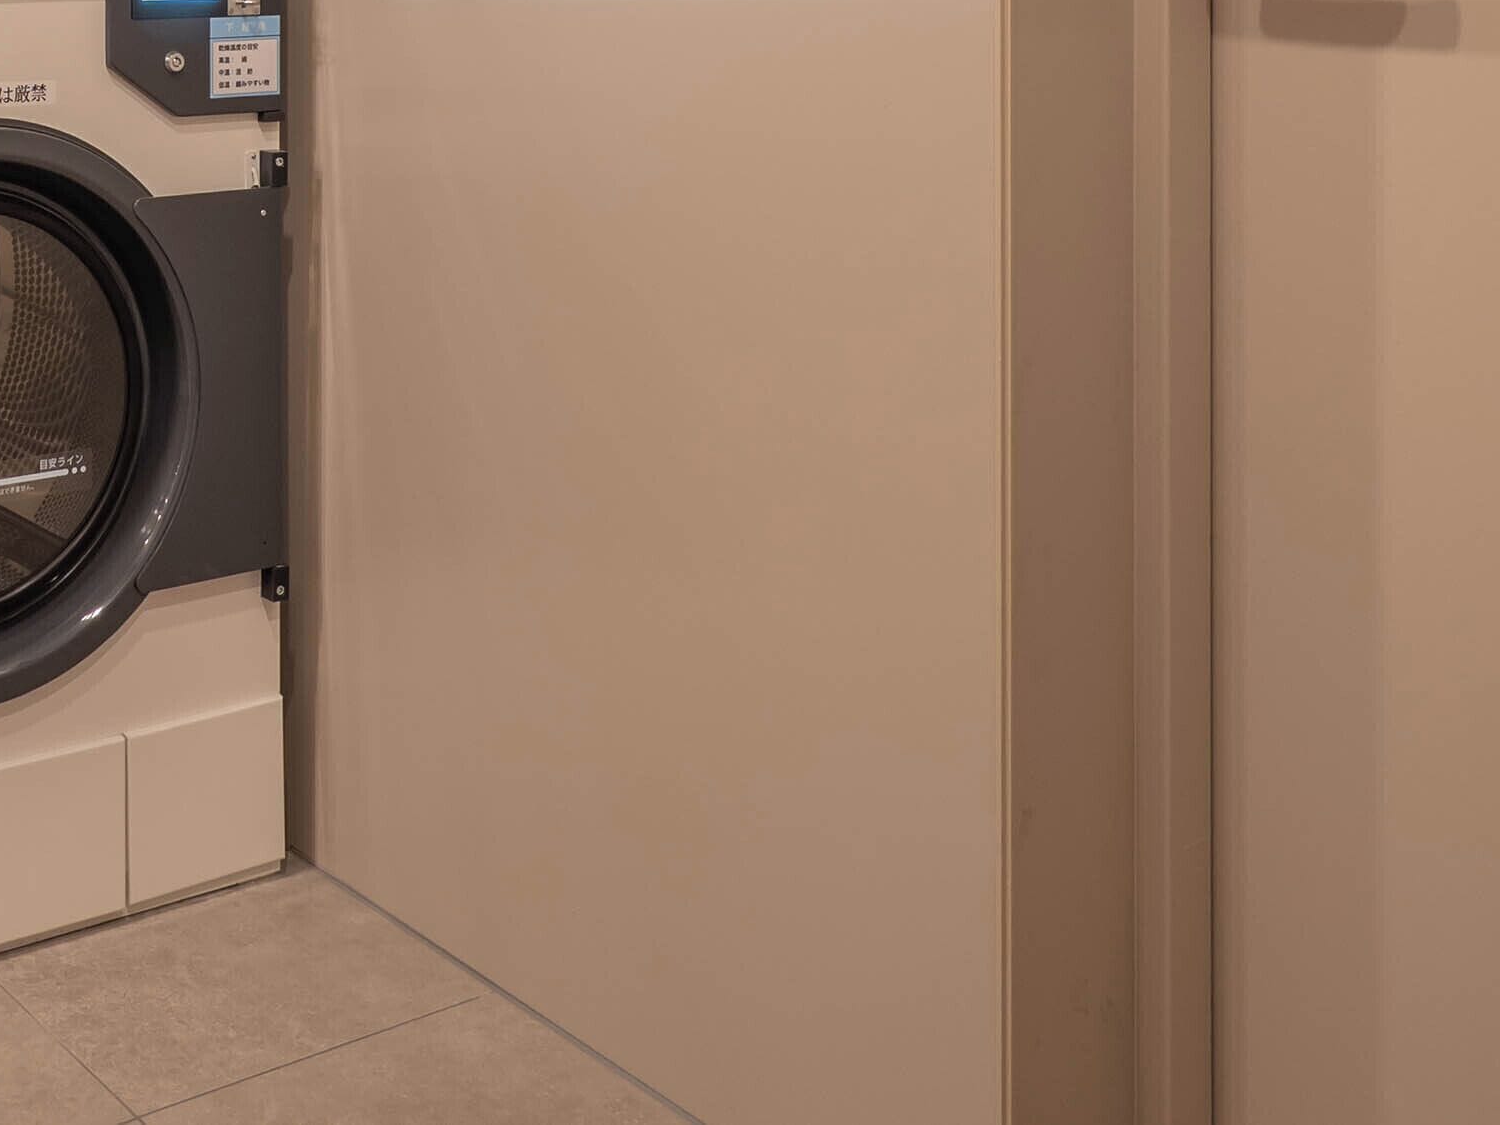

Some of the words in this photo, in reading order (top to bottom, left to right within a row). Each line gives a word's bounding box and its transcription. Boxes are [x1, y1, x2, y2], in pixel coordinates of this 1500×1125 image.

[39, 454, 84, 471] 目安ライン
